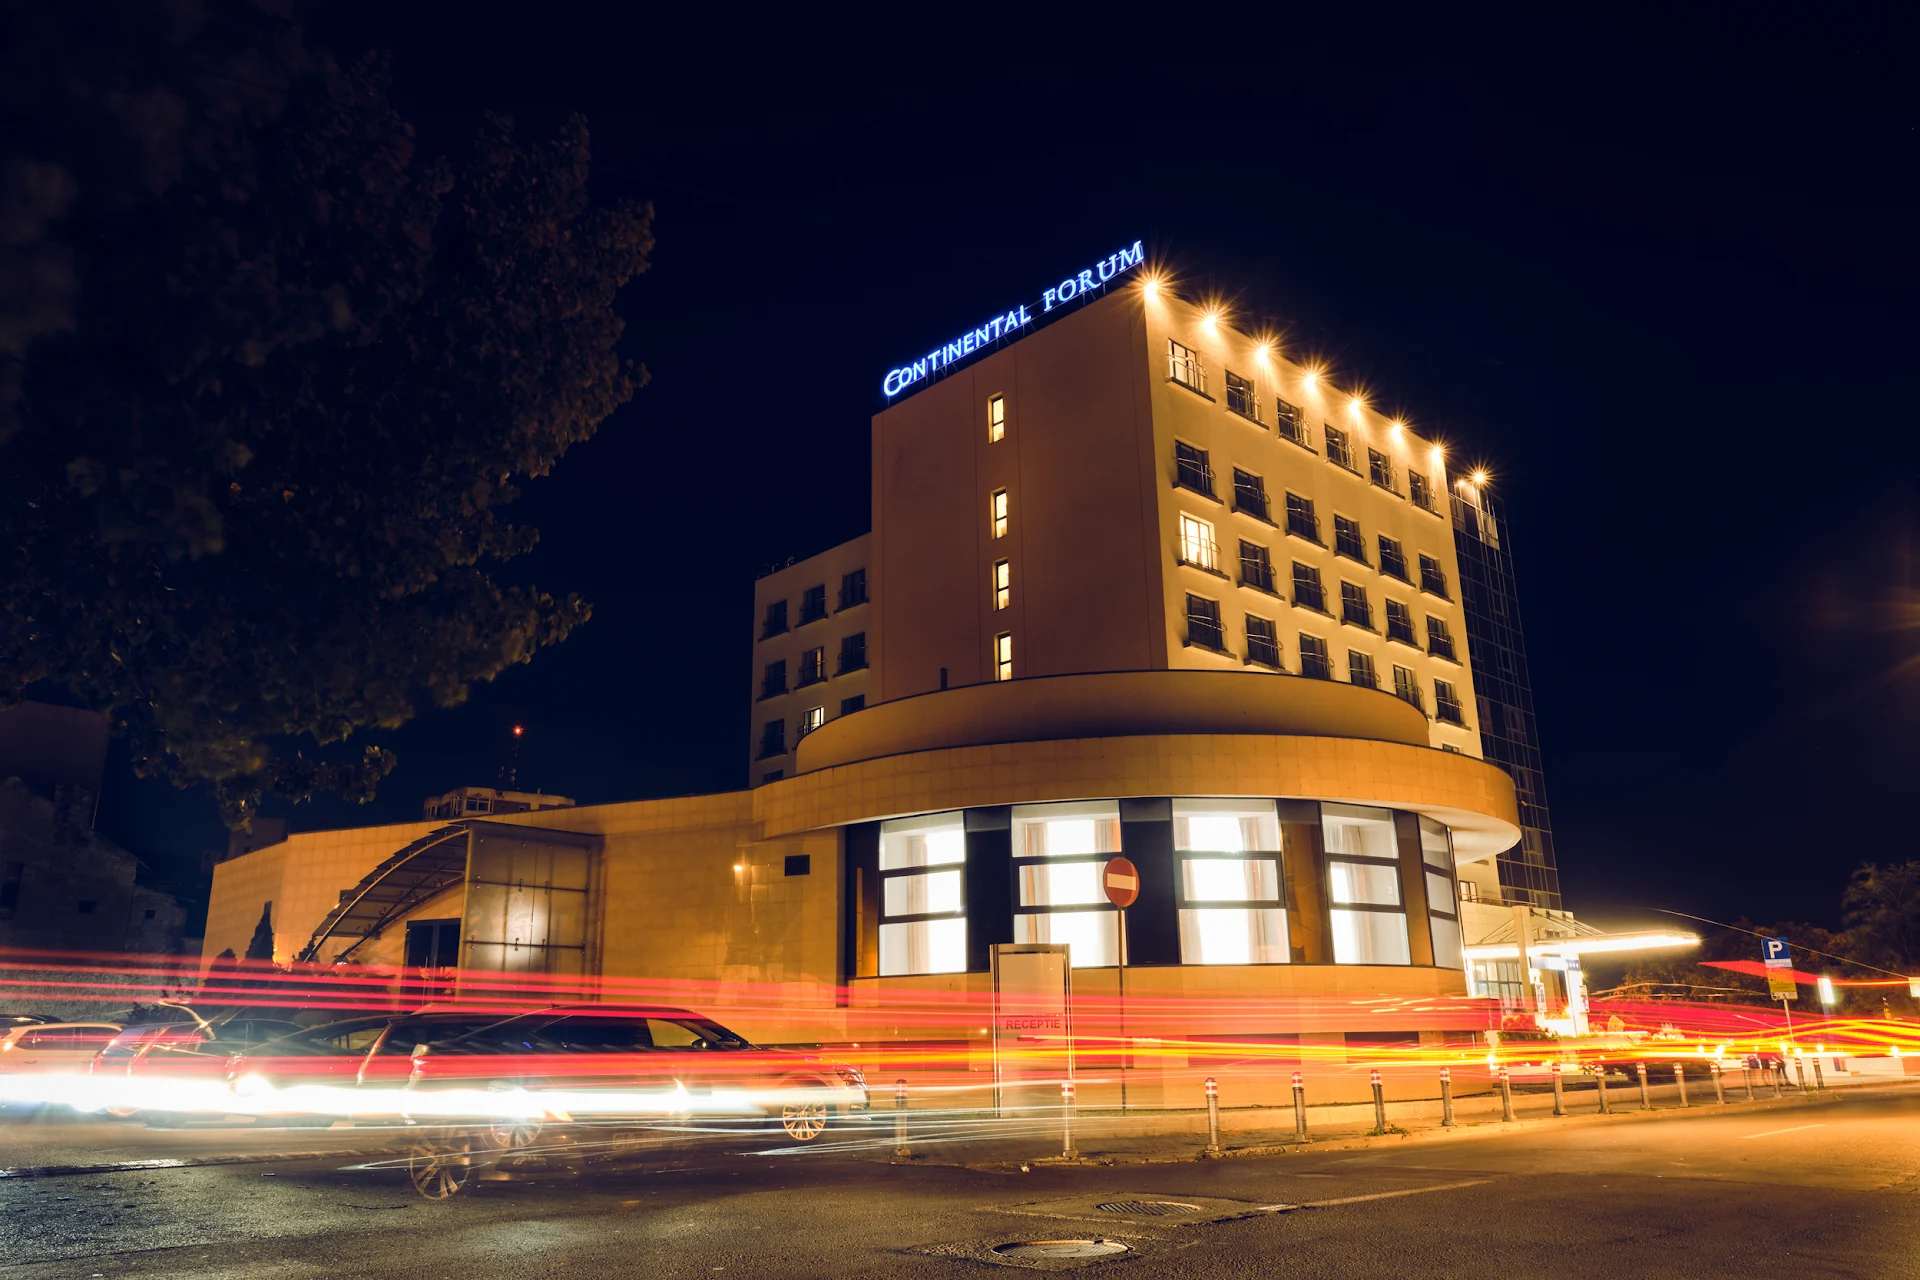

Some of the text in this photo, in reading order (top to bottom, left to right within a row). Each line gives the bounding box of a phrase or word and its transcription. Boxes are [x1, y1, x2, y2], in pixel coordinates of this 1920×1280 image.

[883, 240, 1144, 397] CONTINENTAL FORUM
[1768, 940, 1783, 959] P
[1006, 1019, 1060, 1029] RECEPTIE
